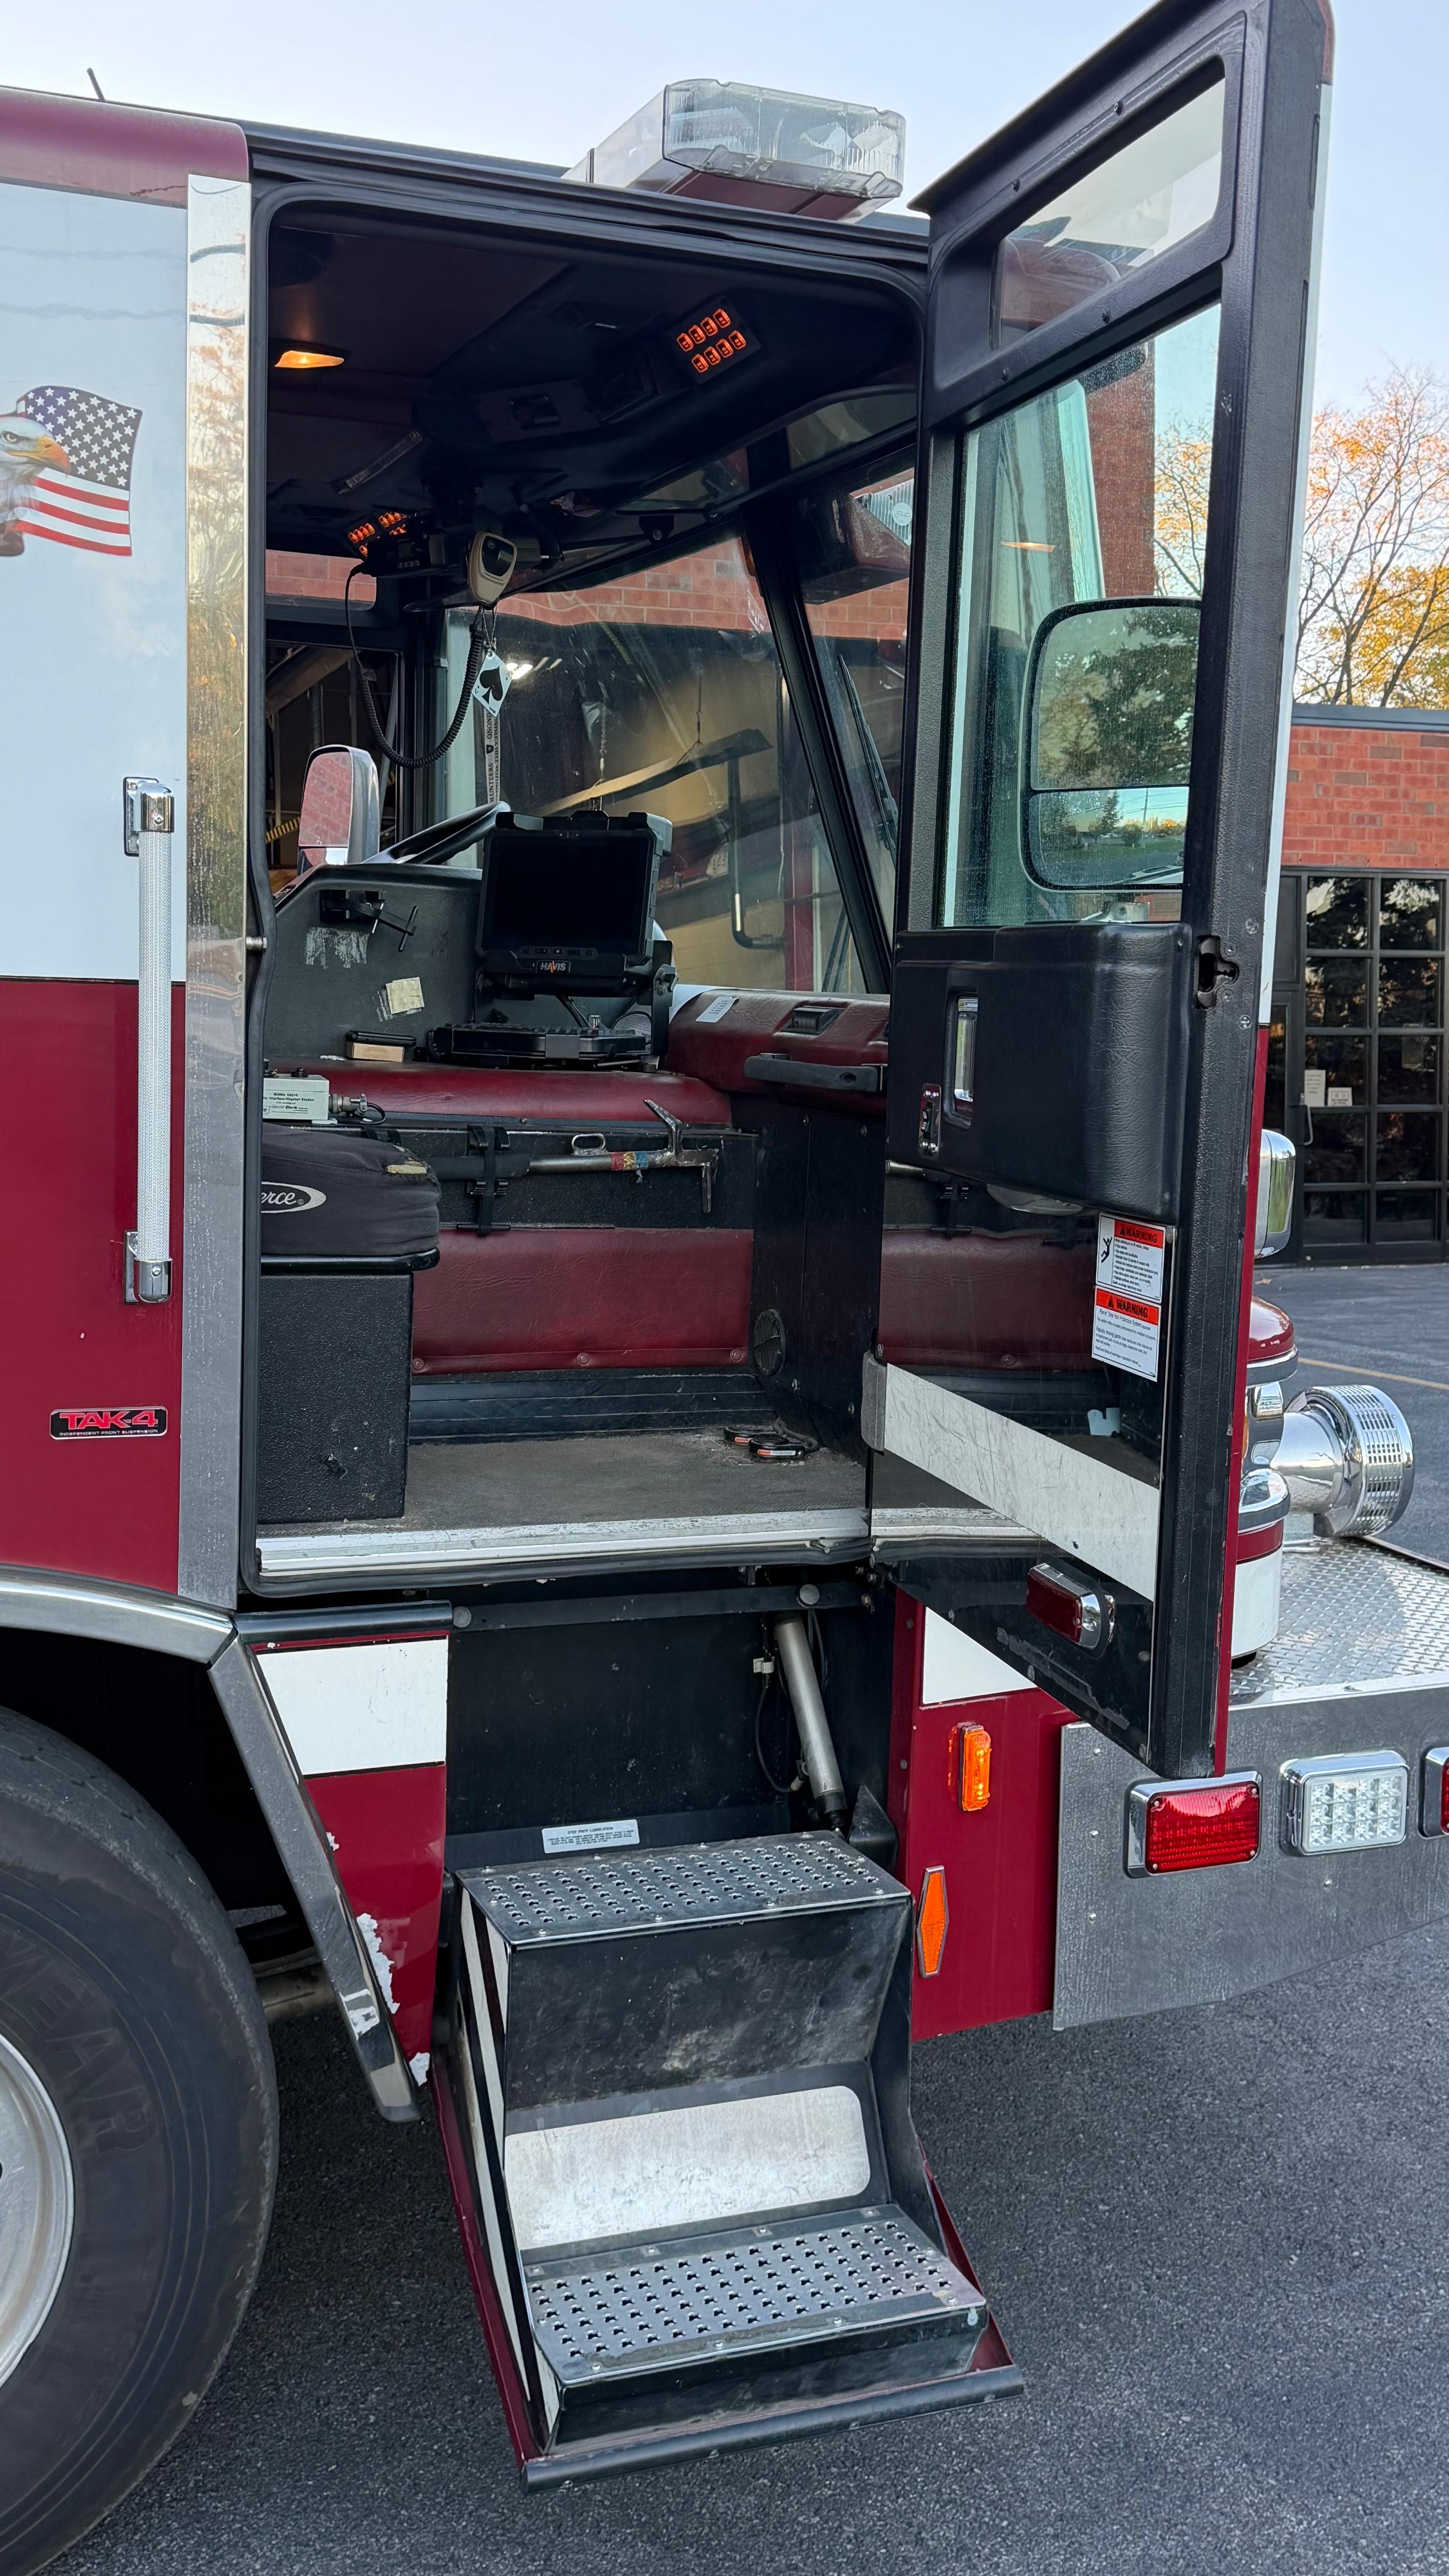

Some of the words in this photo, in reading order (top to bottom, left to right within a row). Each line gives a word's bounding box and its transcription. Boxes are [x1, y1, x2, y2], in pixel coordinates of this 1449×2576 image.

[540, 961, 566, 972] HAVIS
[261, 1191, 297, 1205] erce
[1124, 1226, 1158, 1244] WARNING
[1116, 1297, 1149, 1318] WARNING
[59, 1410, 158, 1430] TAK-4
